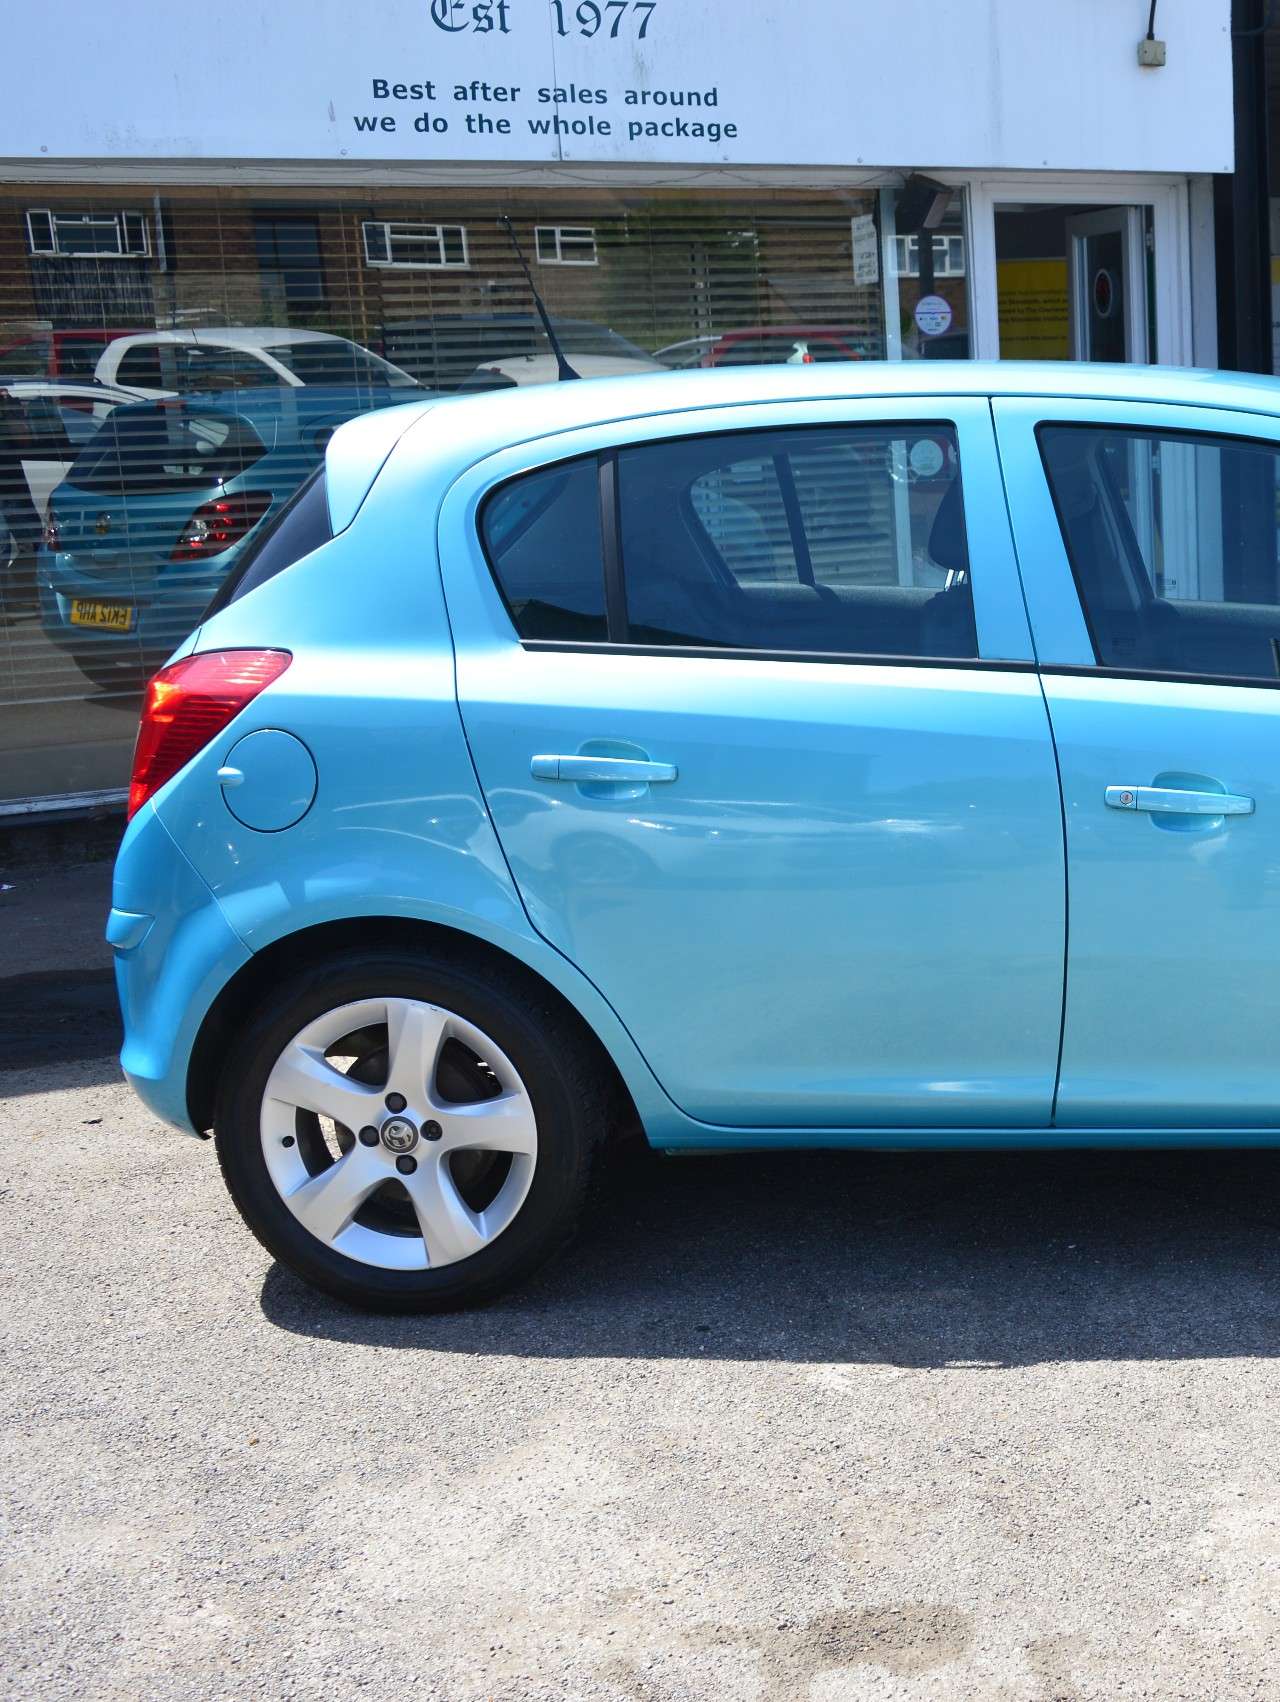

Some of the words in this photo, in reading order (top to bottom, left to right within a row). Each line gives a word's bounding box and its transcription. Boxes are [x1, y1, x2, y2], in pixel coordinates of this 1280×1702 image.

[430, 0, 512, 33] Est
[550, 0, 657, 39] 1977
[372, 79, 436, 101] Best
[453, 81, 521, 102] after
[537, 83, 608, 105] sales
[624, 87, 719, 107] around
[354, 114, 396, 133] we
[414, 112, 449, 134] do
[465, 113, 511, 135] the
[528, 115, 612, 137] whole
[628, 118, 738, 142] package
